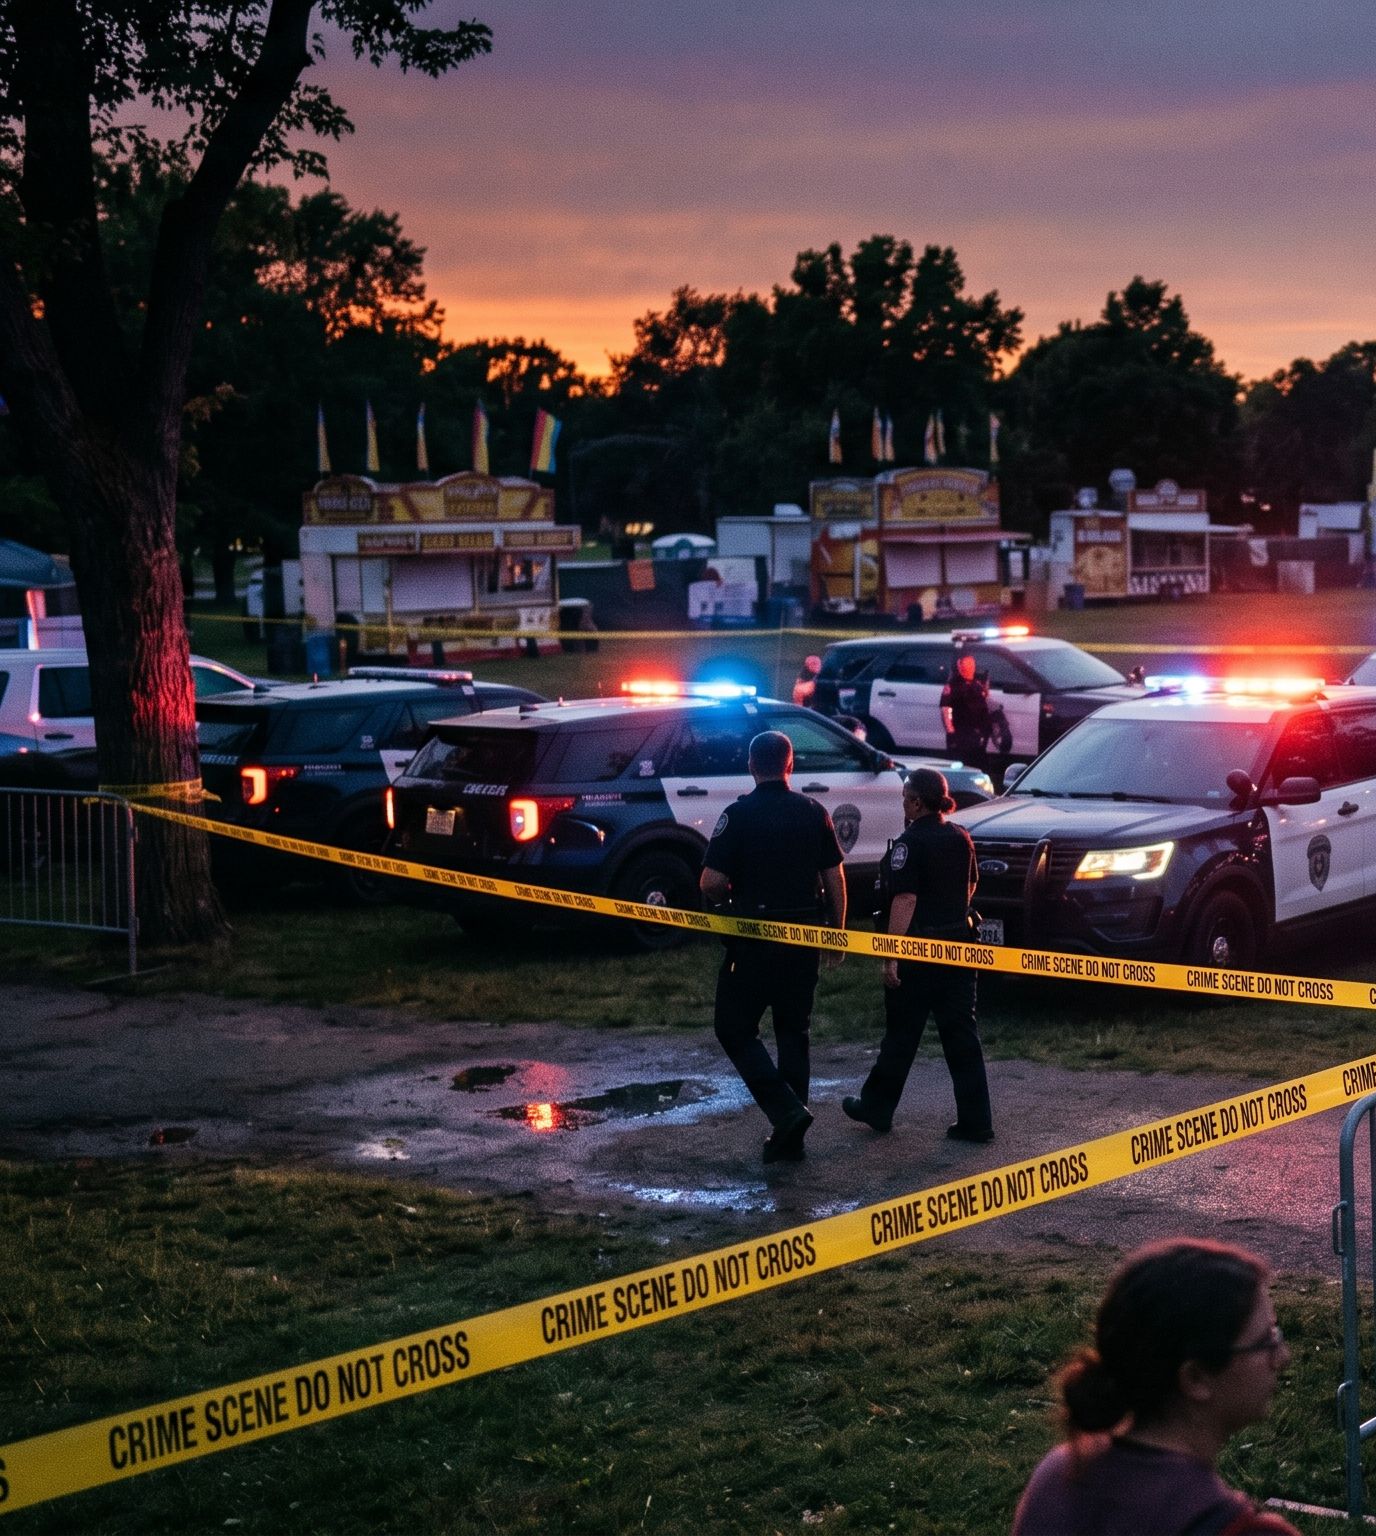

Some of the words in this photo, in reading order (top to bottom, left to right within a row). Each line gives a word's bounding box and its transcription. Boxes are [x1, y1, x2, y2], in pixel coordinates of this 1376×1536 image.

[763, 924, 788, 939] SCENE
[790, 928, 800, 940] DO
[802, 928, 818, 943] NOT
[821, 931, 848, 947] CROSS
[901, 940, 928, 957] SCENE
[931, 943, 942, 958] DO
[945, 945, 962, 960] NOT
[964, 947, 994, 965] CROSS
[1021, 952, 1050, 972] CRIME
[1053, 956, 1084, 976] SCENE
[1086, 959, 1100, 978] DO
[1102, 961, 1120, 978] NOT
[1123, 964, 1156, 984] CROSS
[1187, 970, 1219, 990] CRIME
[1222, 974, 1254, 992] SCENE
[1258, 977, 1271, 994] DO
[1274, 978, 1295, 997] NOT
[1298, 981, 1333, 1000] CROSS
[1130, 1124, 1174, 1165] CRIME
[1177, 1109, 1218, 1151] SCENE
[1220, 1102, 1238, 1134] DO
[1241, 1095, 1264, 1129] NOT
[1268, 1084, 1307, 1120] CROSS
[871, 1202, 923, 1246] CRIME
[928, 1185, 978, 1228] SCENE
[982, 1178, 1004, 1212] DO
[1007, 1166, 1036, 1202] NOT
[1040, 1151, 1088, 1195] CROSS
[541, 1292, 607, 1345] CRIME
[614, 1272, 677, 1322] SCENE
[683, 1266, 709, 1301] DO
[714, 1251, 750, 1292] NOT
[757, 1232, 816, 1280] CROSS
[109, 1406, 196, 1470] CRIME
[205, 1381, 289, 1442] SCENE
[298, 1371, 330, 1417] DO
[339, 1355, 385, 1405] NOT
[393, 1331, 470, 1387] CROSS
